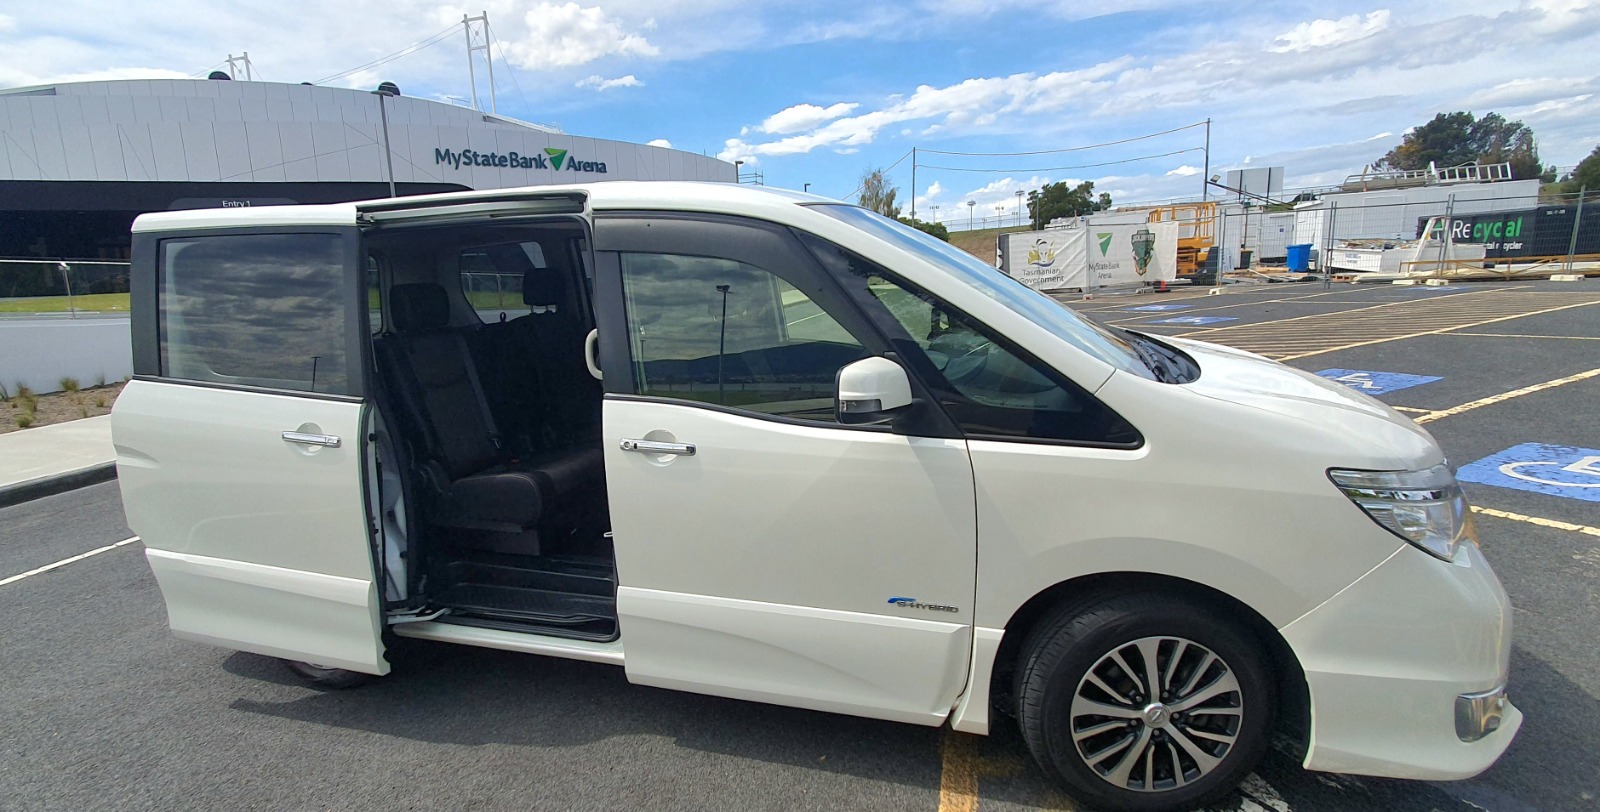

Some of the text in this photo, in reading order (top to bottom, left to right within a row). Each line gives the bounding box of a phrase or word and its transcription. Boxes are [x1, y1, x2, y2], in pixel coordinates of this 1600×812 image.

[434, 147, 607, 174] MyStateBank Arena
[222, 200, 245, 208] Entry
[1022, 268, 1060, 276] Tasmanian
[1019, 275, 1065, 284] Government
